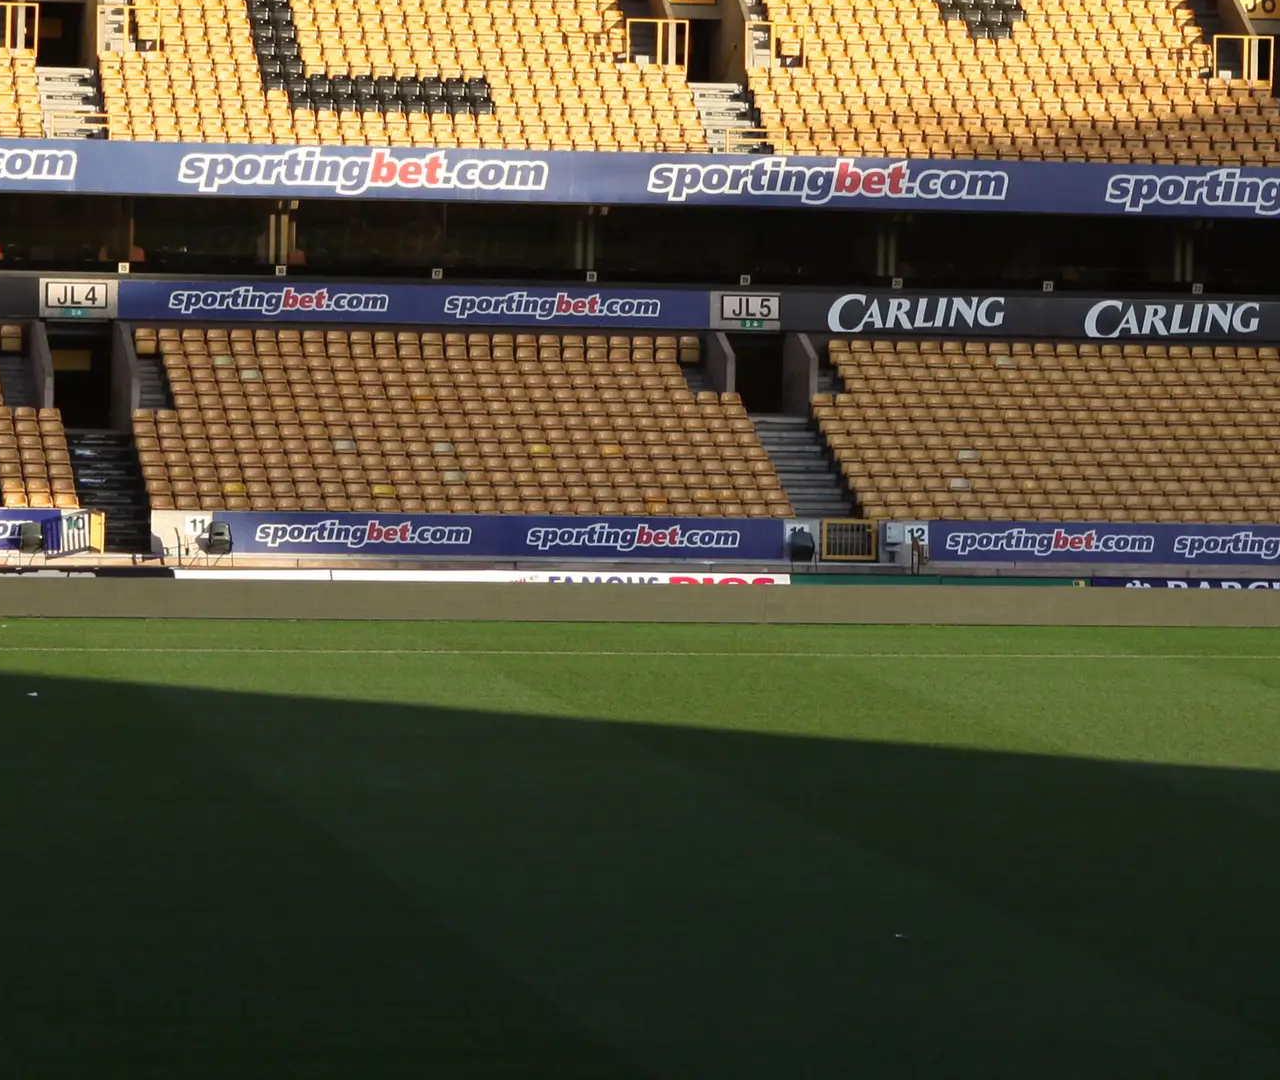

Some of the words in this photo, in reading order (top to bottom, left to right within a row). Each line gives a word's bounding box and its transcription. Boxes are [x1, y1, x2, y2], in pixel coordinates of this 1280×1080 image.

[178, 147, 549, 194] sportingbet.com
[647, 157, 1009, 204] sportingbet.com
[56, 285, 98, 306] JL4
[169, 286, 389, 314] sportingbet.com
[444, 291, 660, 320] sportingbet.com
[732, 296, 772, 318] JL5
[827, 293, 1005, 332] CARLING
[1084, 300, 1260, 338] CARLING
[255, 520, 472, 549] sportingbet.com
[526, 522, 740, 552] sportingbet.com
[945, 528, 1155, 556] sportingbet.com
